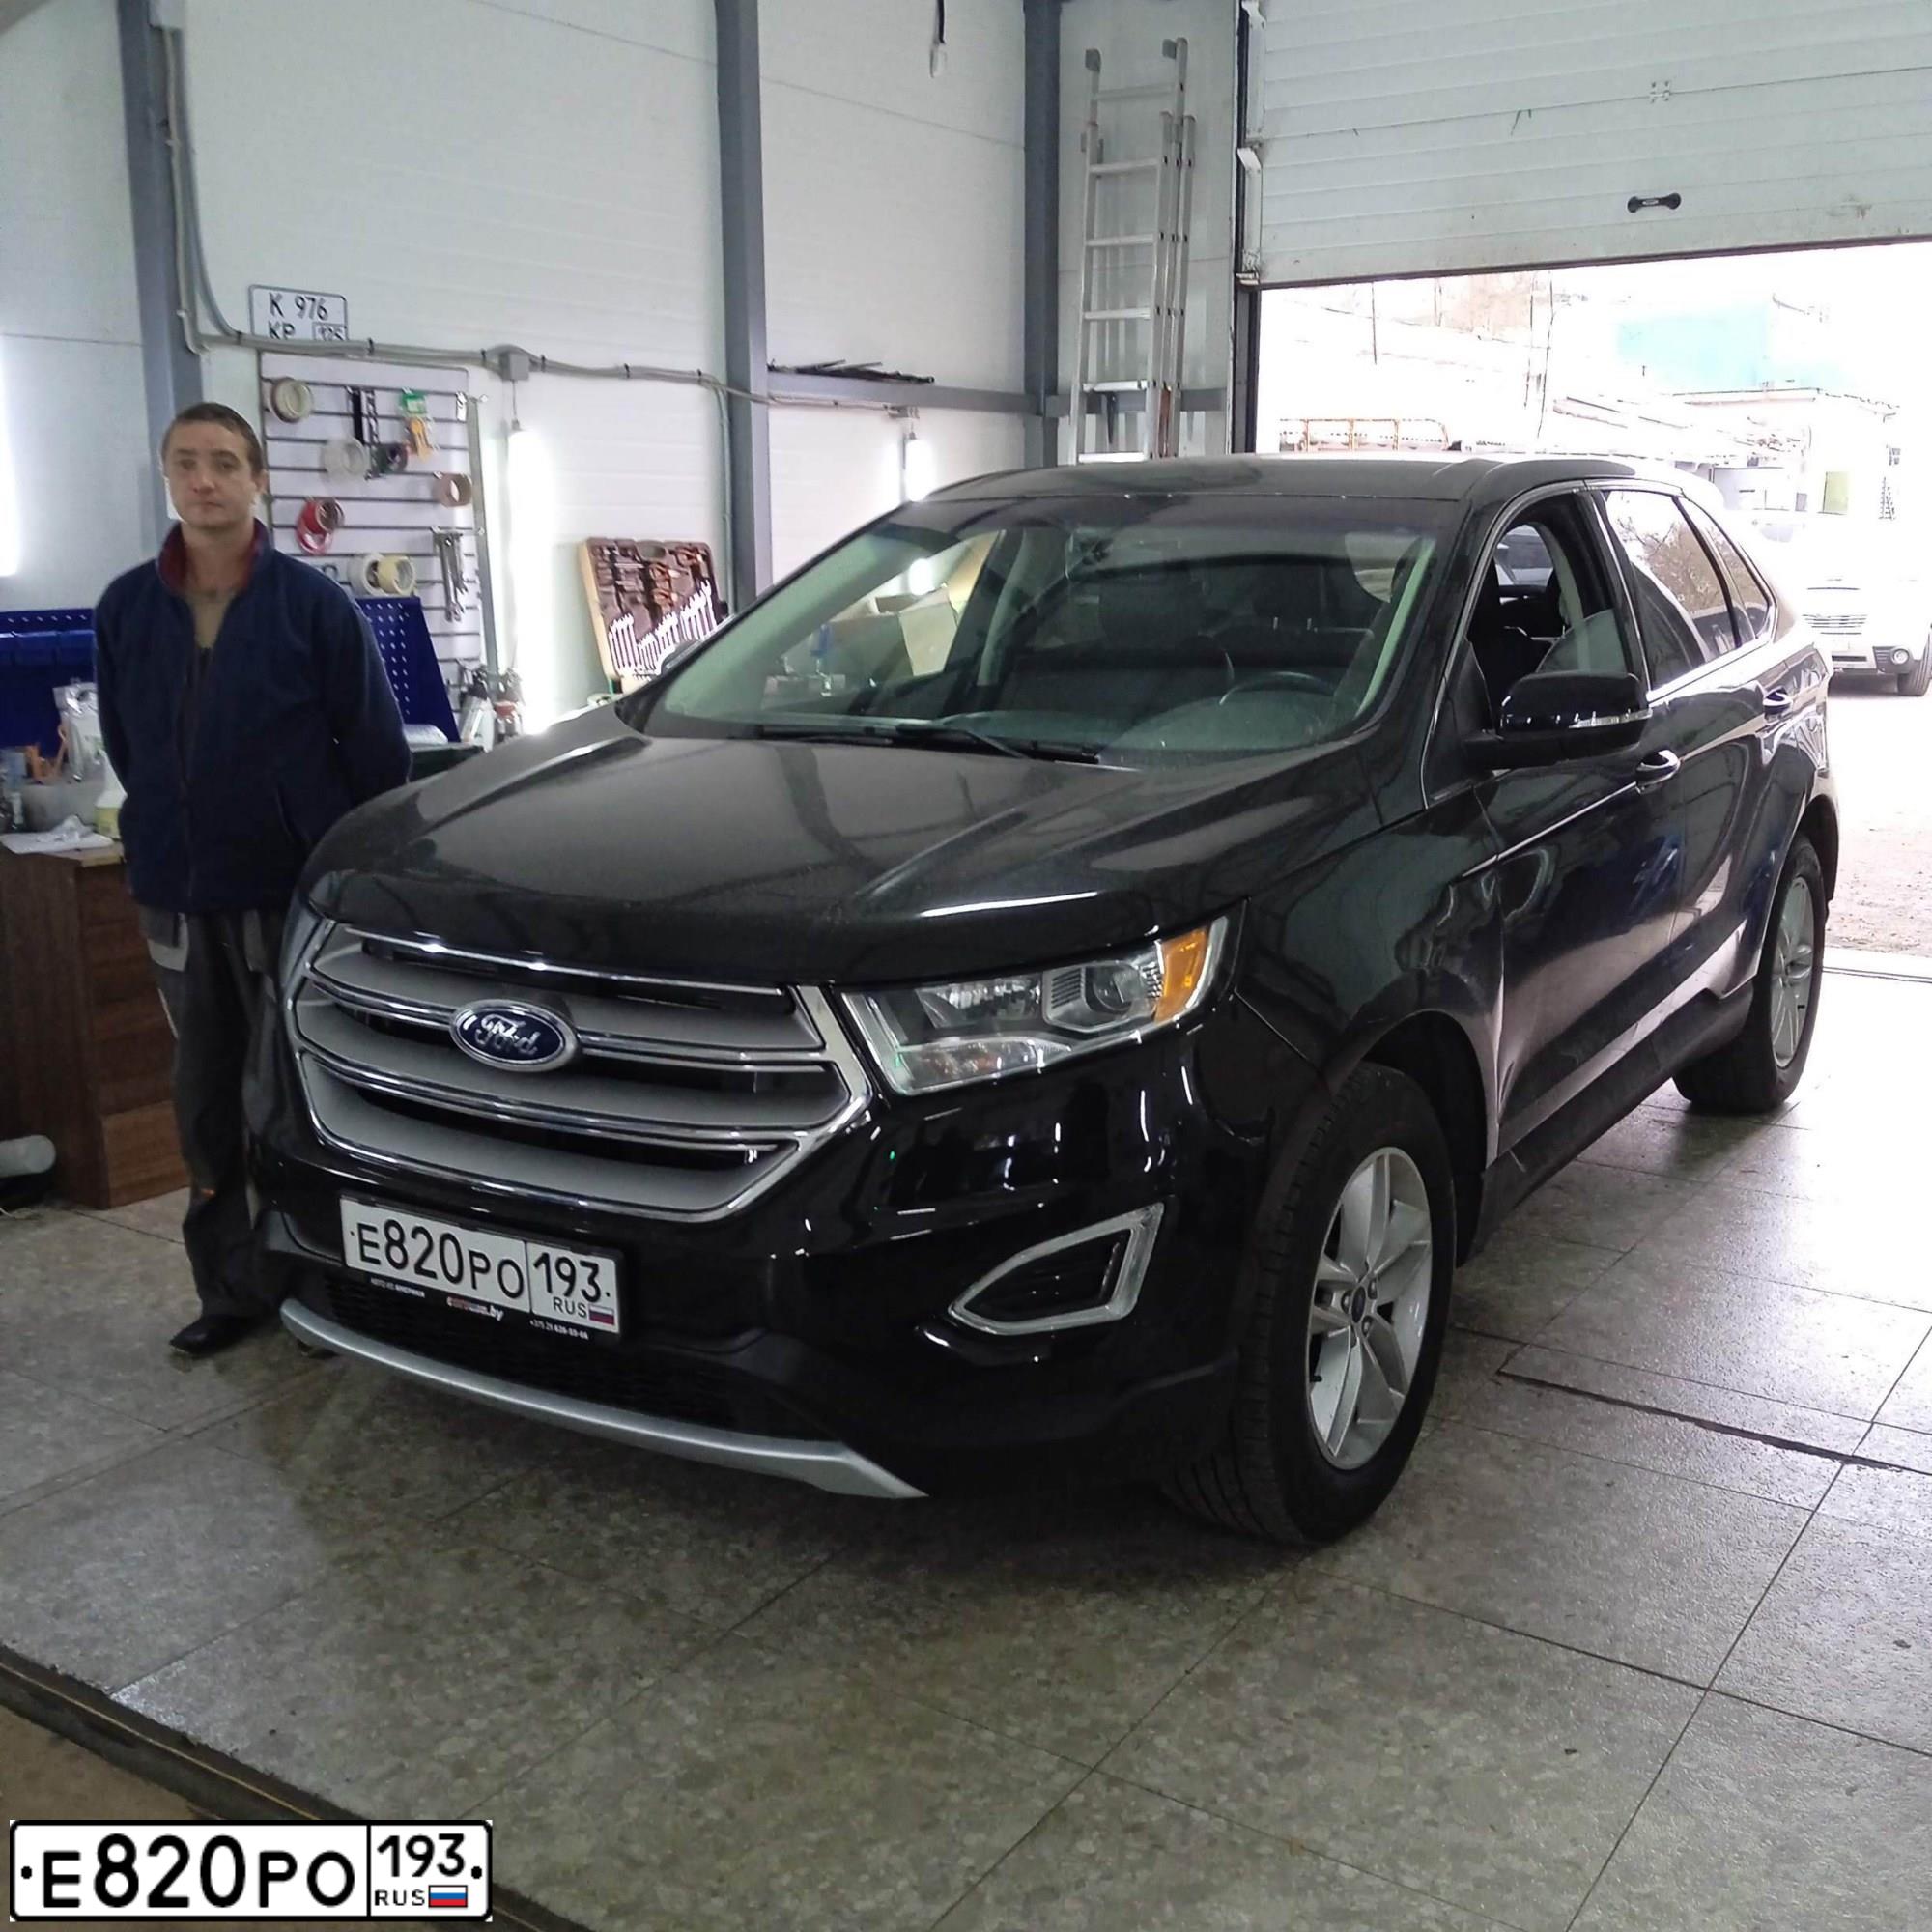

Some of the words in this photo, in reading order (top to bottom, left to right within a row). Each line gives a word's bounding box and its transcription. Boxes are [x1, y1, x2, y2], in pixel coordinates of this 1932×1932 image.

[294, 295, 328, 321] 976
[475, 1013, 542, 1055] Ford
[532, 1252, 600, 1303] 193
[553, 1296, 587, 1319] RUS
